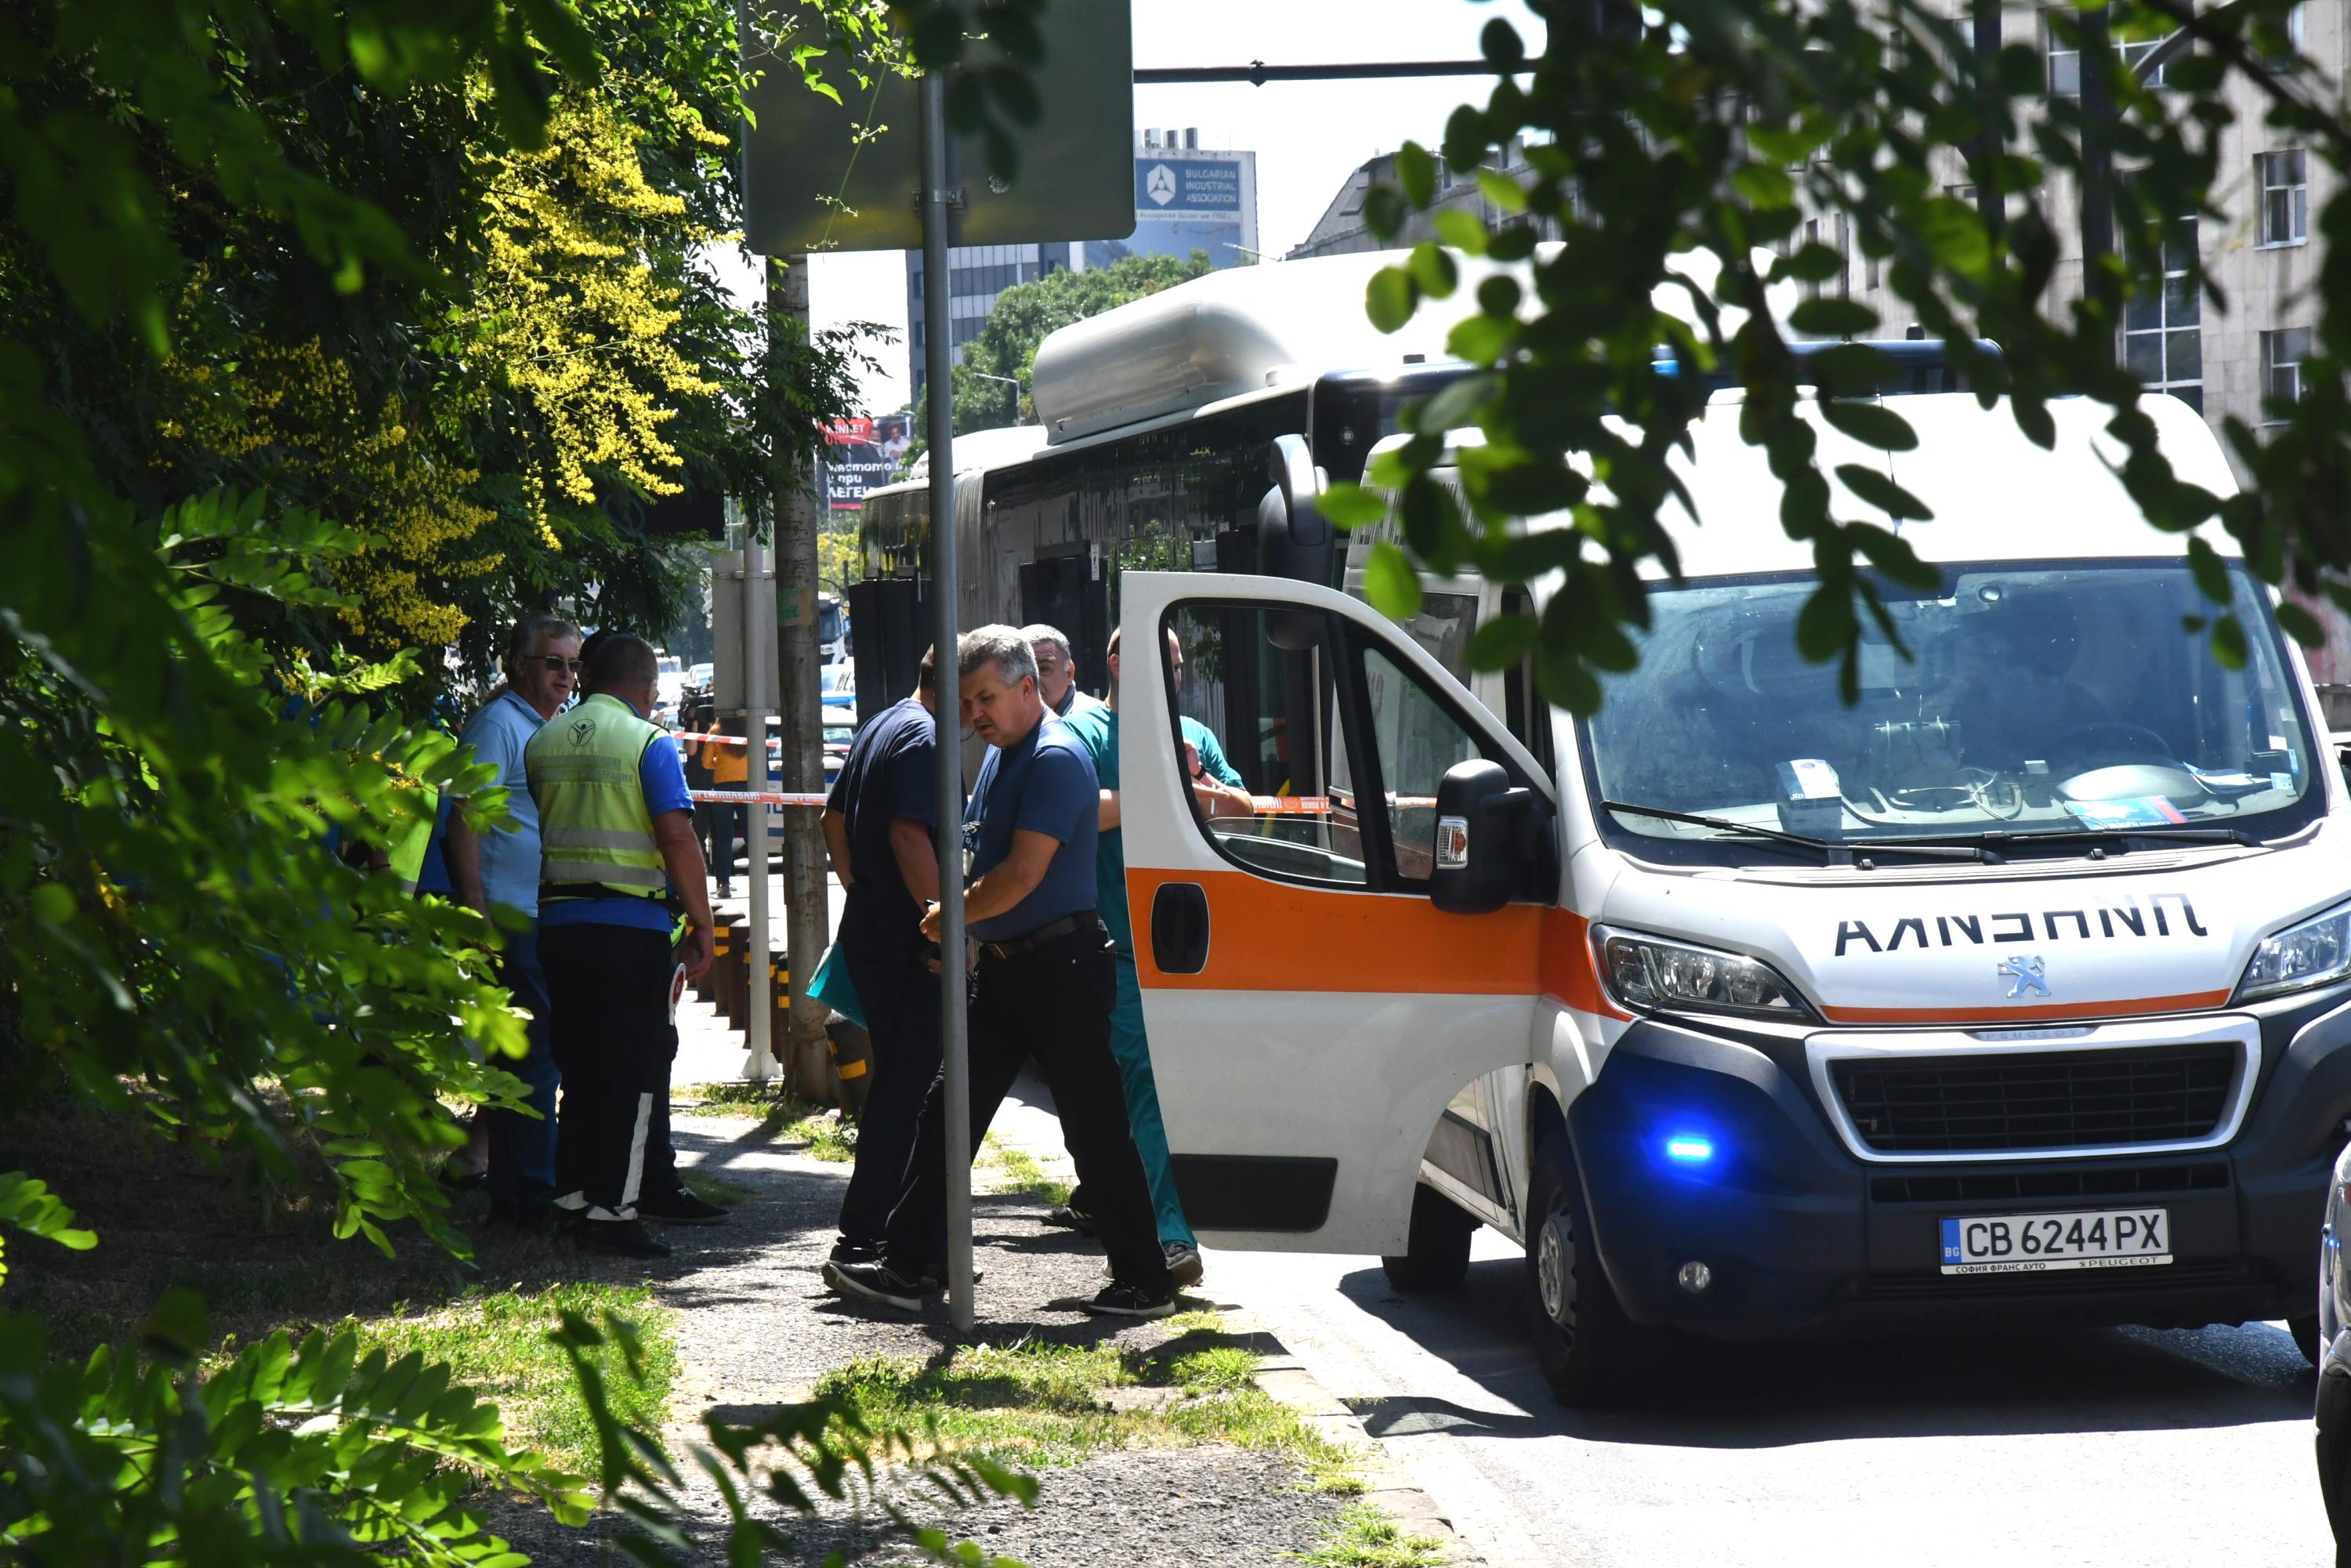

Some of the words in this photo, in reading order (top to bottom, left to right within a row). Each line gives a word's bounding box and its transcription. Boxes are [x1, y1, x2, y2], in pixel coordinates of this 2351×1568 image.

[1185, 169, 1236, 179] BULGARIAN
[1185, 181, 1236, 190] INDUSTRIAL
[1186, 193, 1237, 203] ASSOCIATION
[1944, 1247, 1960, 1258] BG
[1966, 1222, 2013, 1258] CB
[2021, 1218, 2108, 1255] 6244
[2115, 1214, 2161, 1251] PX
[2088, 1256, 2159, 1268] PEUGEOT
[1955, 1265, 1988, 1274] СОФИЯ
[1990, 1263, 2021, 1273] ФРАНС
[2023, 1262, 2046, 1271] АУТО
